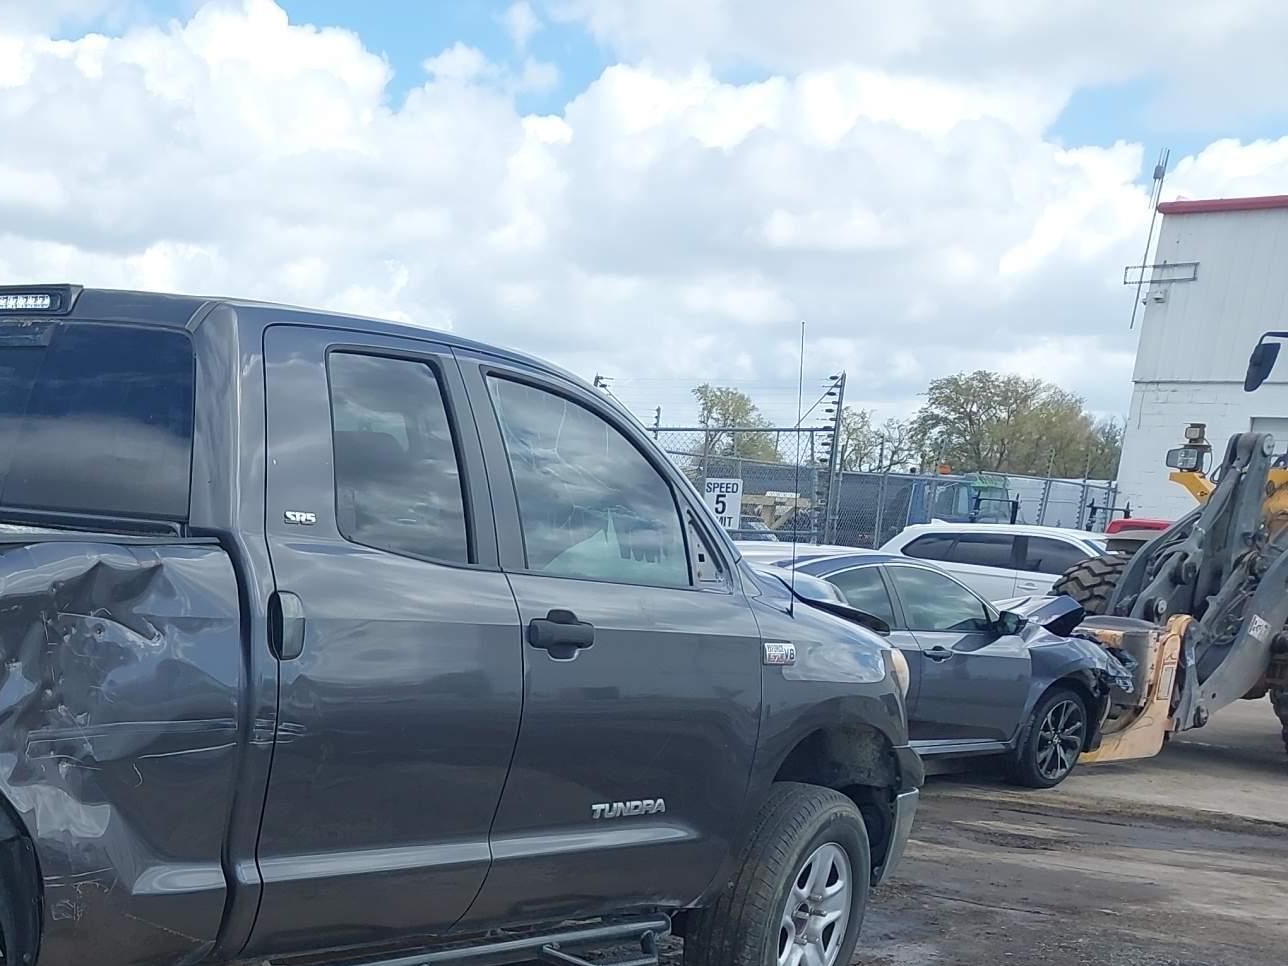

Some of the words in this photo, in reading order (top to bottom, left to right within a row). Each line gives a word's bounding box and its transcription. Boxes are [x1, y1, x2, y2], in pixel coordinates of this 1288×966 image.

[706, 482, 739, 493] SPEED
[715, 494, 726, 514] 5
[284, 511, 316, 525] SR5
[591, 798, 666, 819] TUNDRA
